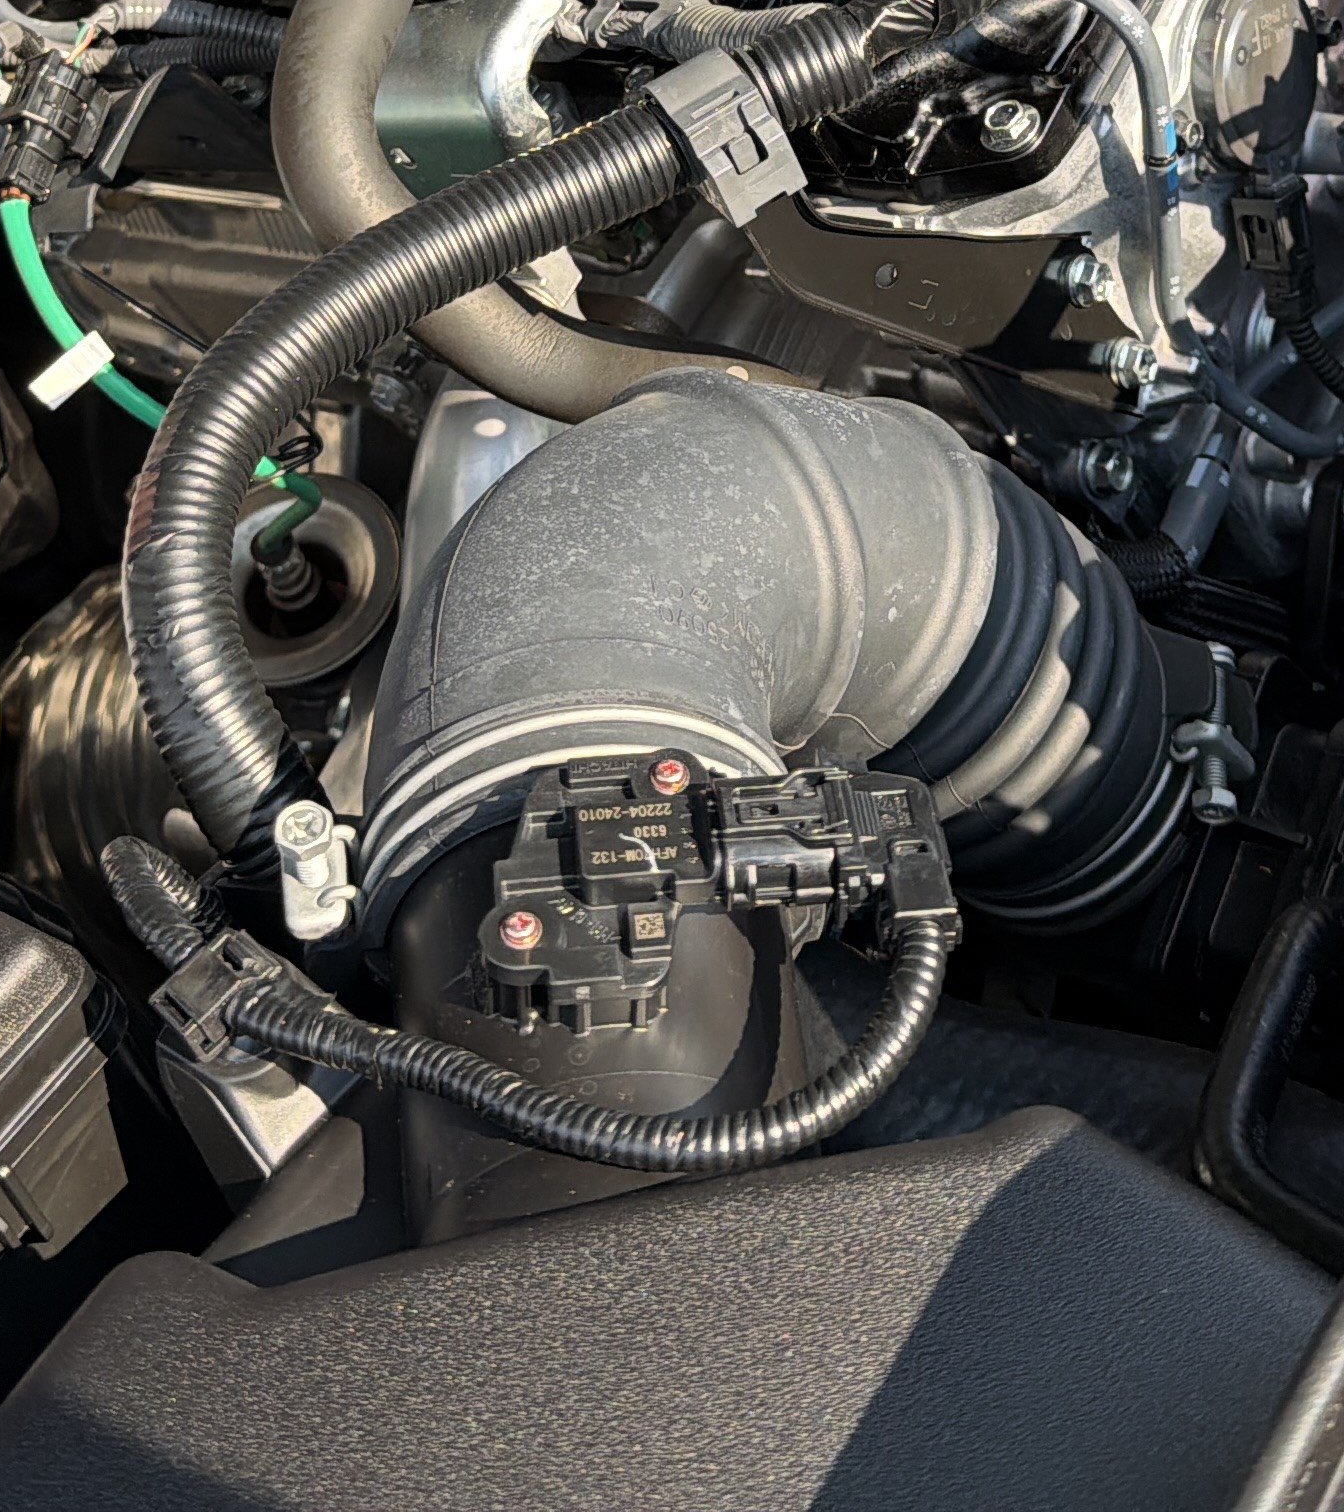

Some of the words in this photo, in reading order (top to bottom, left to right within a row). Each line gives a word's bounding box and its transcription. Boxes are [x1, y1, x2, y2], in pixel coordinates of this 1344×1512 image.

[578, 802, 673, 822] 22204-24010
[633, 824, 667, 838] 6330
[591, 845, 679, 865] AFH0M-132
